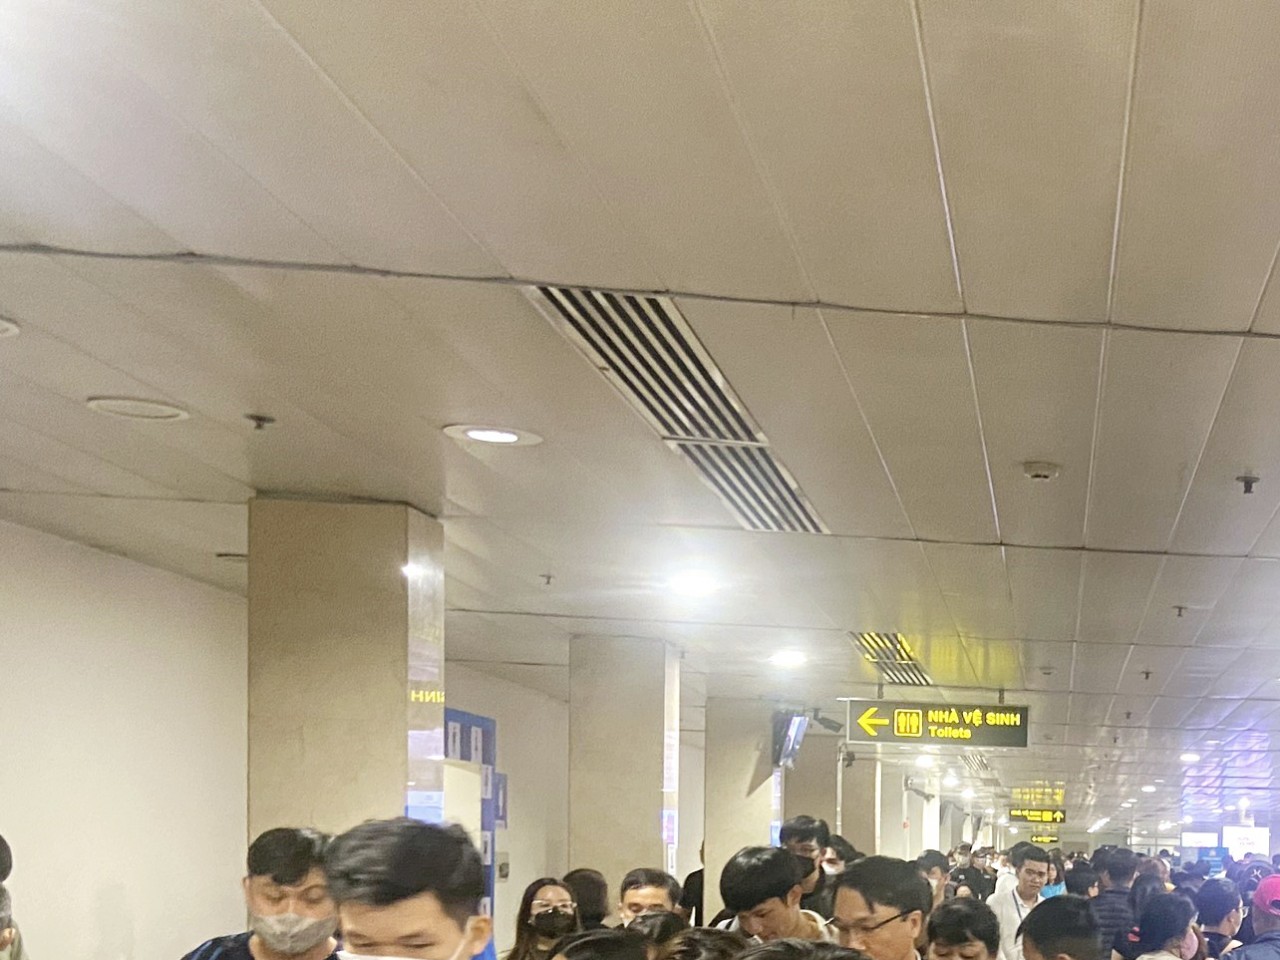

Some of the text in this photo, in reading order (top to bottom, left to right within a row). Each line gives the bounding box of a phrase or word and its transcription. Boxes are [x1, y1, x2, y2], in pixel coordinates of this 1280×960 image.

[927, 708, 1021, 727] NHÀ VỆ SINH
[928, 726, 972, 739] Toilets
